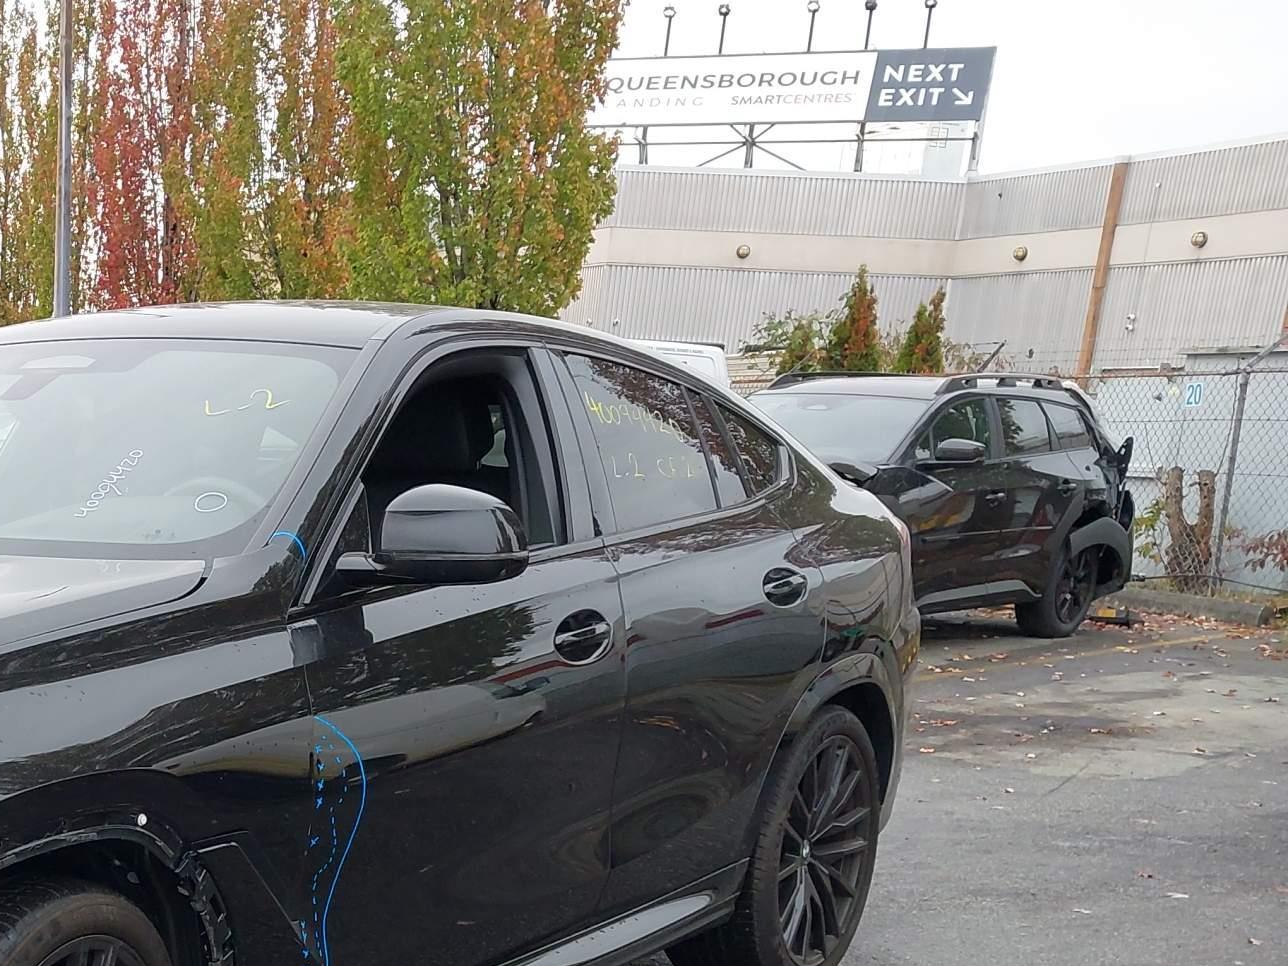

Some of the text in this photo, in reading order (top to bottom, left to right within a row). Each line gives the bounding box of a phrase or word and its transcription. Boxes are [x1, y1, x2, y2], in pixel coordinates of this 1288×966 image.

[607, 70, 860, 94] QUEENSBOROUGH
[882, 63, 965, 83] NEXT
[603, 96, 704, 109] ANDING
[730, 93, 853, 106] SMARTCENTRES
[877, 87, 945, 107] EXIT
[1186, 383, 1202, 405] 20
[72, 449, 144, 518] 40094420
